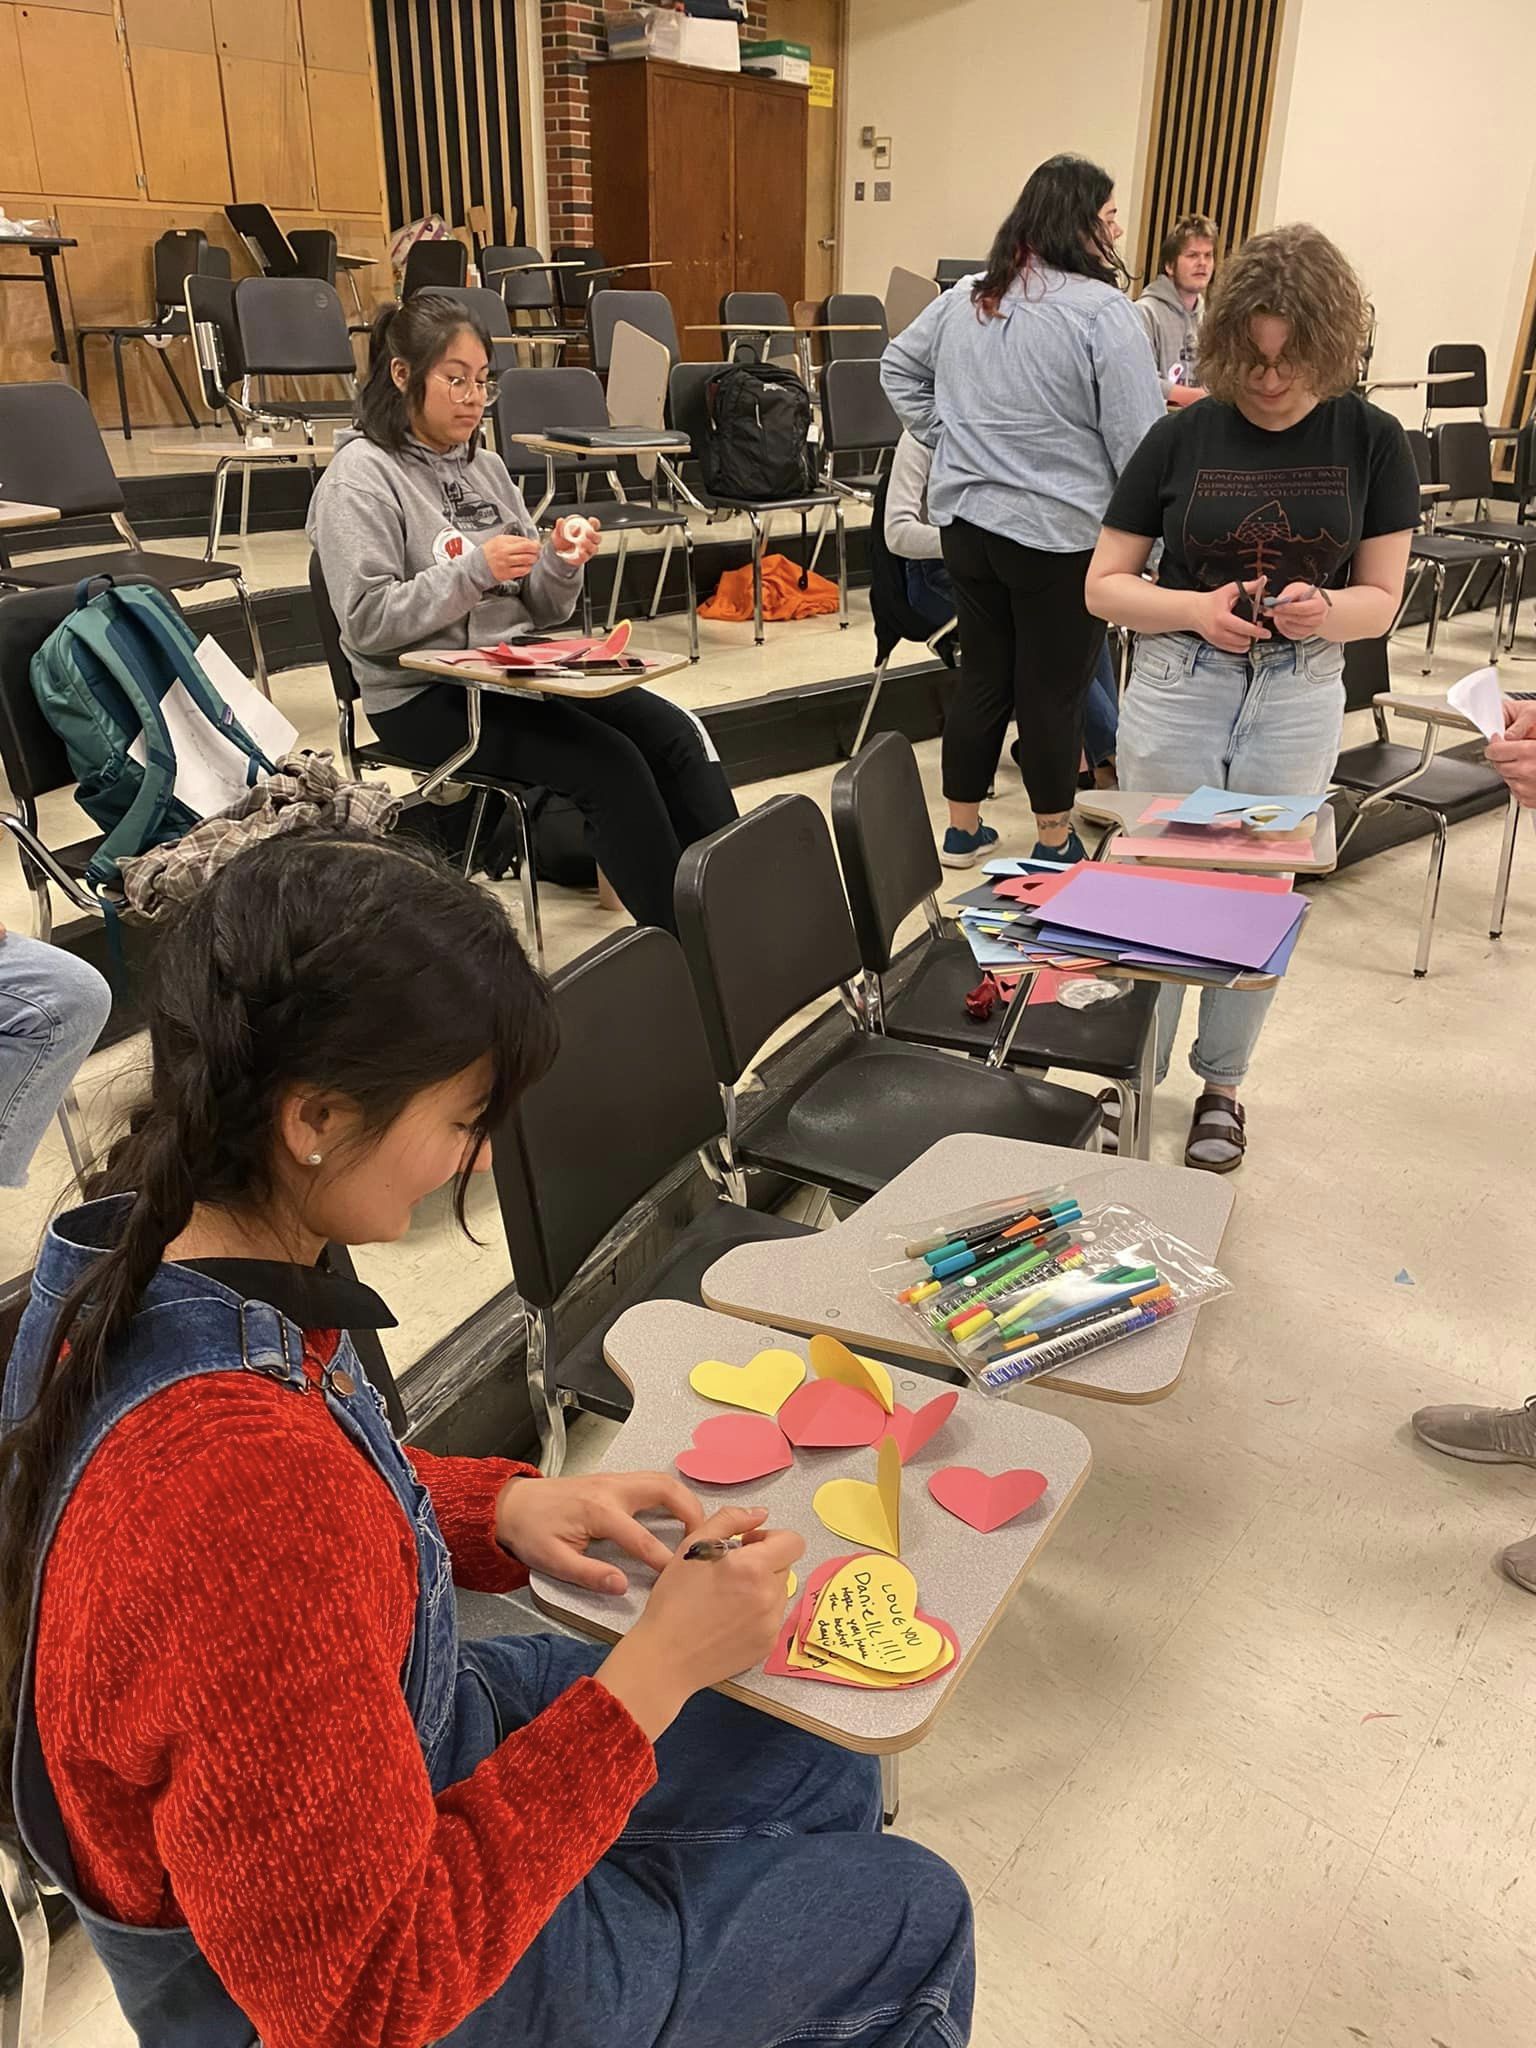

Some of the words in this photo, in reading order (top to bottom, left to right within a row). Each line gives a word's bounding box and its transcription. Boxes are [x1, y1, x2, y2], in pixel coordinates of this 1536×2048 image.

[1201, 472, 1286, 481] REMEMBERING
[1292, 471, 1312, 480] THE
[1318, 470, 1343, 479] PAST
[1197, 488, 1258, 497] SEEKING
[1263, 488, 1345, 496] SOLUTIONS
[900, 1626, 923, 1647] YOU
